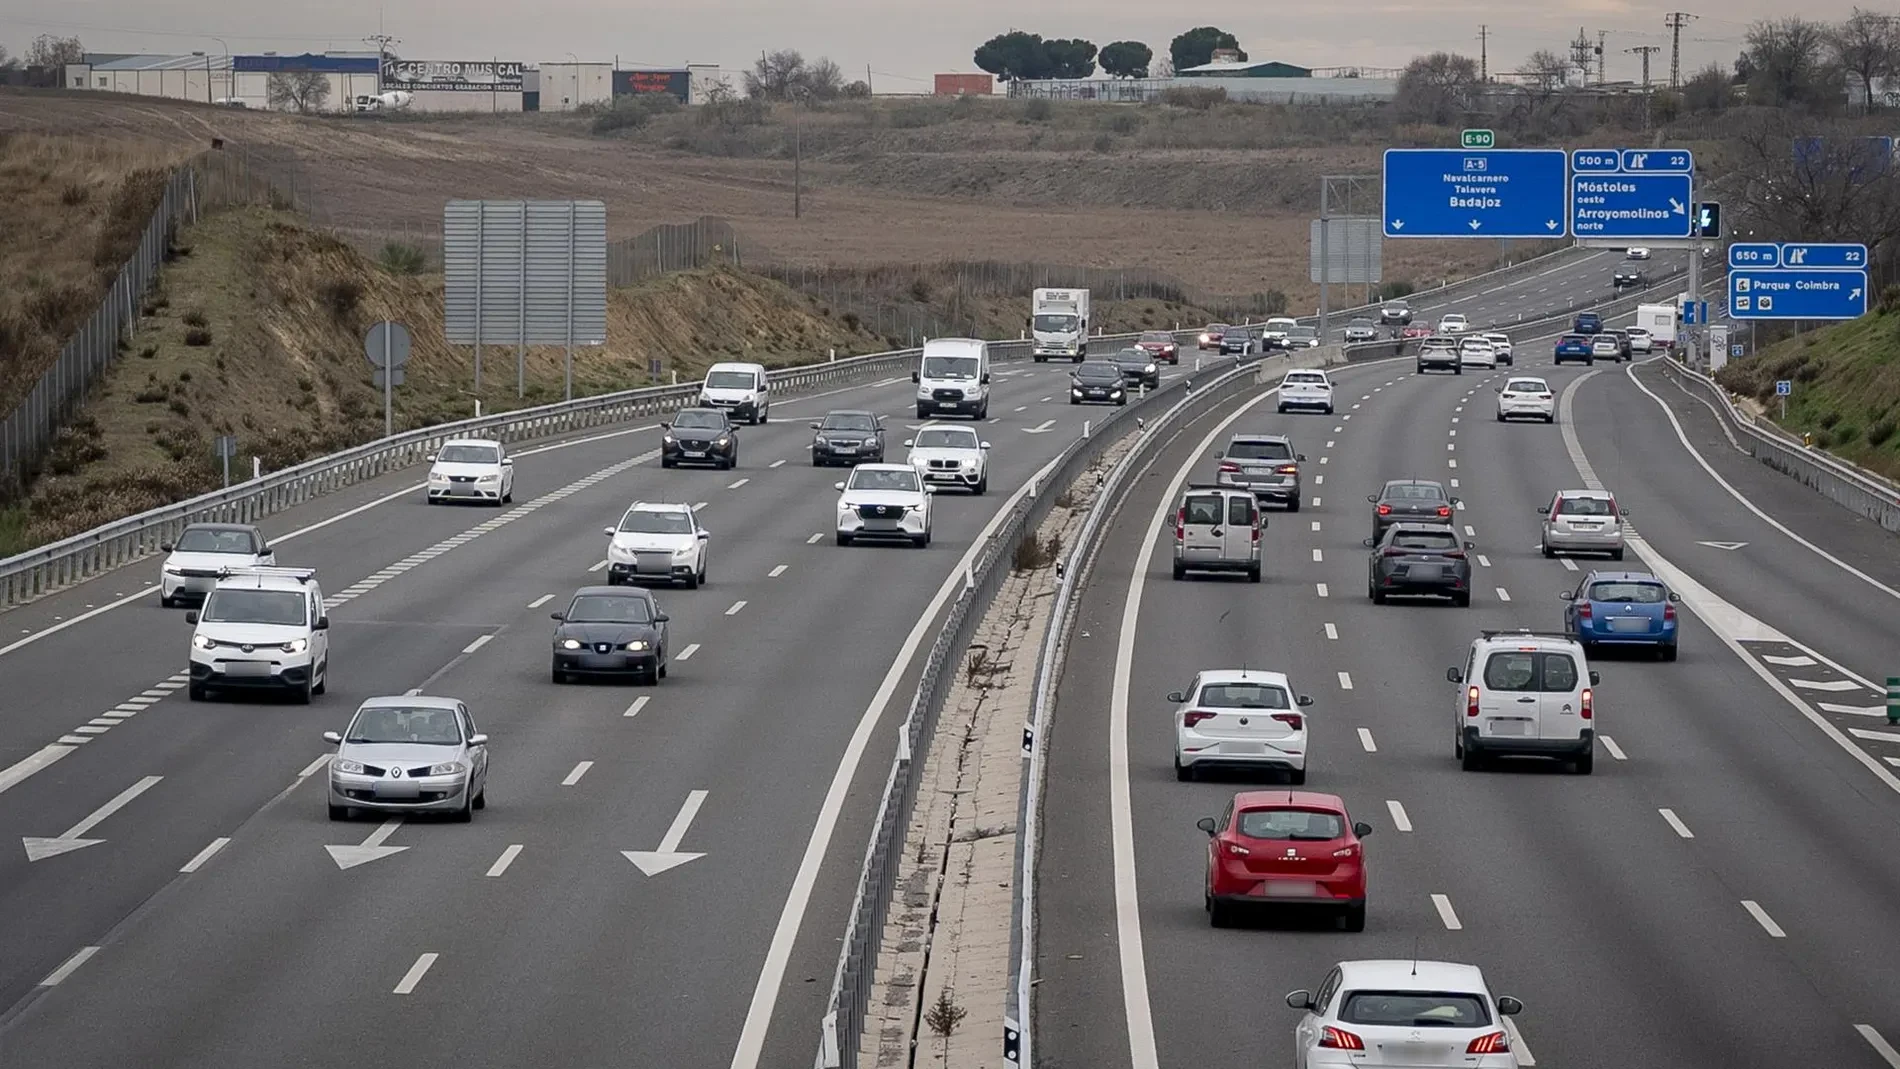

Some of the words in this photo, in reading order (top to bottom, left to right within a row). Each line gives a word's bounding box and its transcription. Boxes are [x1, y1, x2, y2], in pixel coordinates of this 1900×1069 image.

[408, 63, 461, 75] CENTRO
[1465, 134, 1490, 144] E-90
[1466, 160, 1485, 169] A-5
[1579, 156, 1602, 165] 500
[1670, 156, 1685, 165] 22
[1443, 173, 1510, 183] Navalcarnero
[1454, 185, 1496, 194] Talavera
[1577, 181, 1637, 193] Móstoles
[1449, 196, 1502, 209] Badajoz
[1577, 196, 1606, 204] oeste
[1577, 208, 1670, 221] Arroyomolinos
[1577, 222, 1604, 230] norte
[1735, 251, 1758, 260] 650
[1762, 252, 1773, 260] m
[1845, 252, 1860, 261] 22
[1753, 280, 1791, 290] Parque
[1795, 280, 1840, 290] Coimbra
